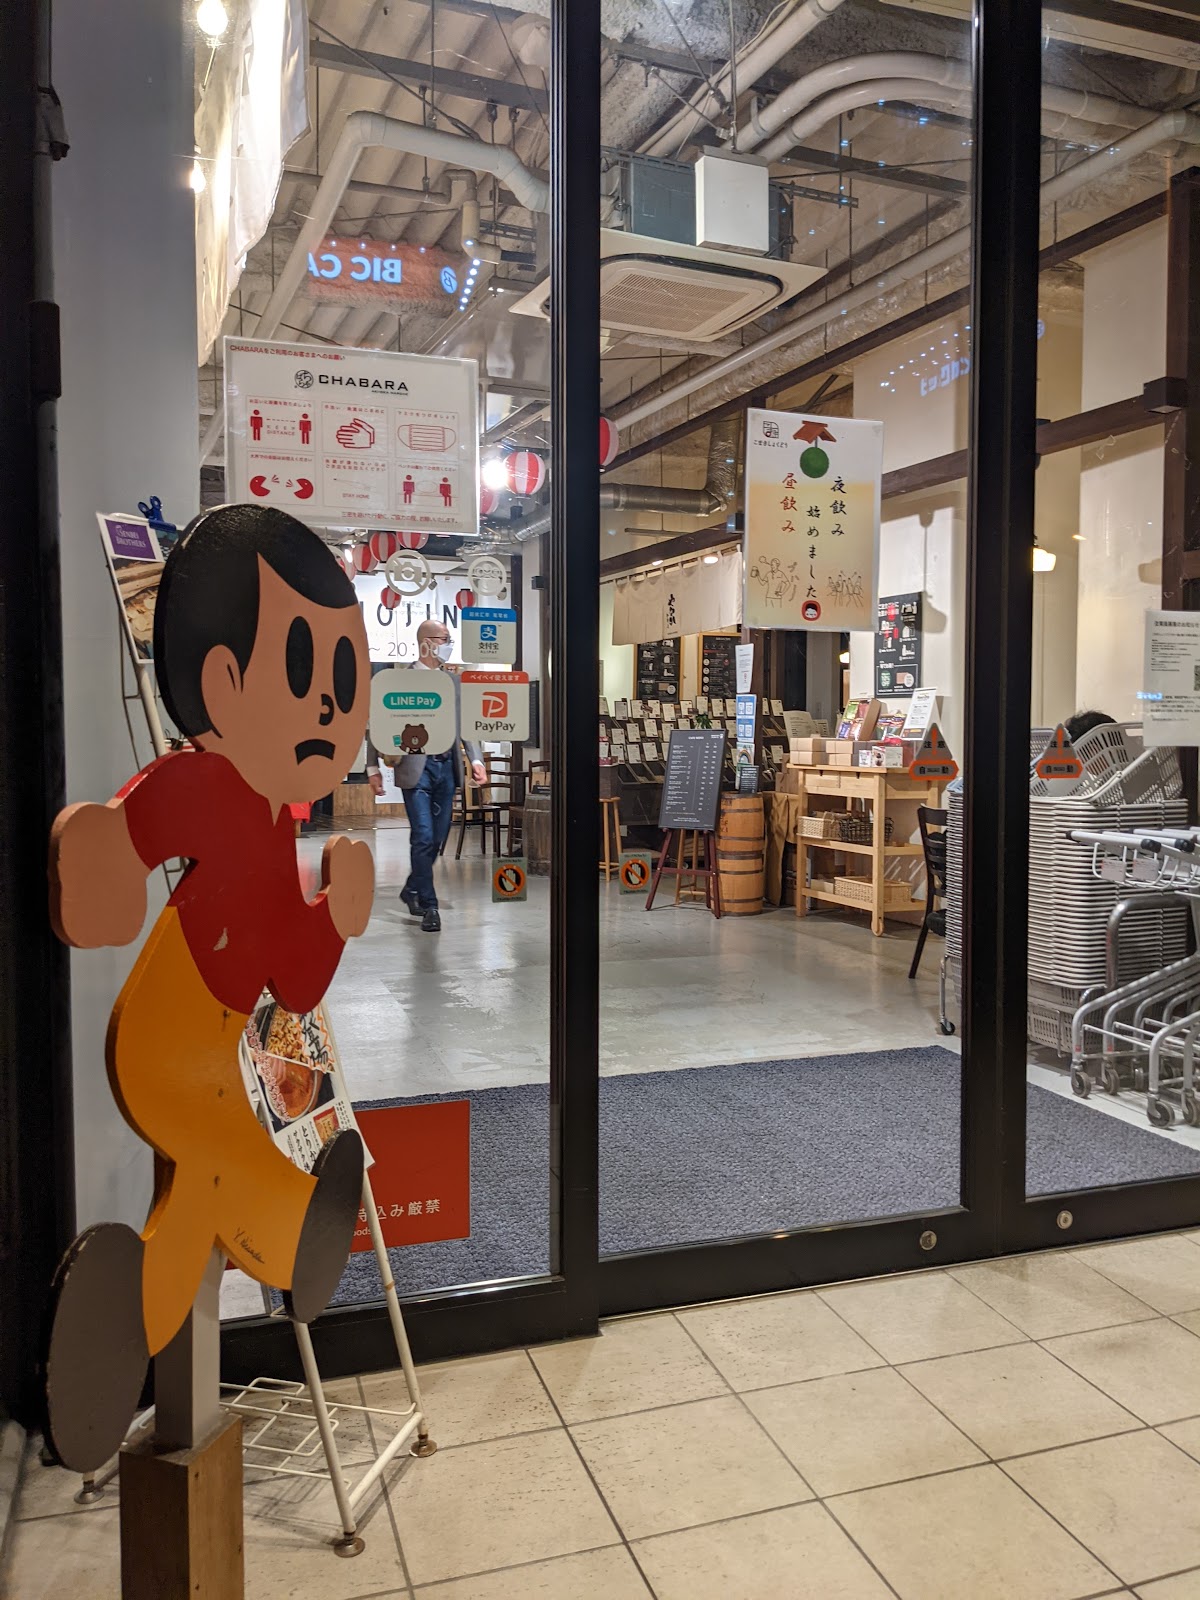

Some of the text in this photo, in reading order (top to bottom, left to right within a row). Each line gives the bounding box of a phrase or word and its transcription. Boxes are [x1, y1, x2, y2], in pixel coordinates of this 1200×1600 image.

[318, 374, 409, 392] CHABARA
[266, 429, 296, 437] DISTANCE
[780, 472, 798, 533] 昼飲み
[829, 476, 848, 537] 夜飲み
[115, 536, 147, 549] BROTHERS
[805, 505, 822, 599] 始めました
[390, 696, 436, 708] LINE Pay
[474, 720, 516, 733] PayPay
